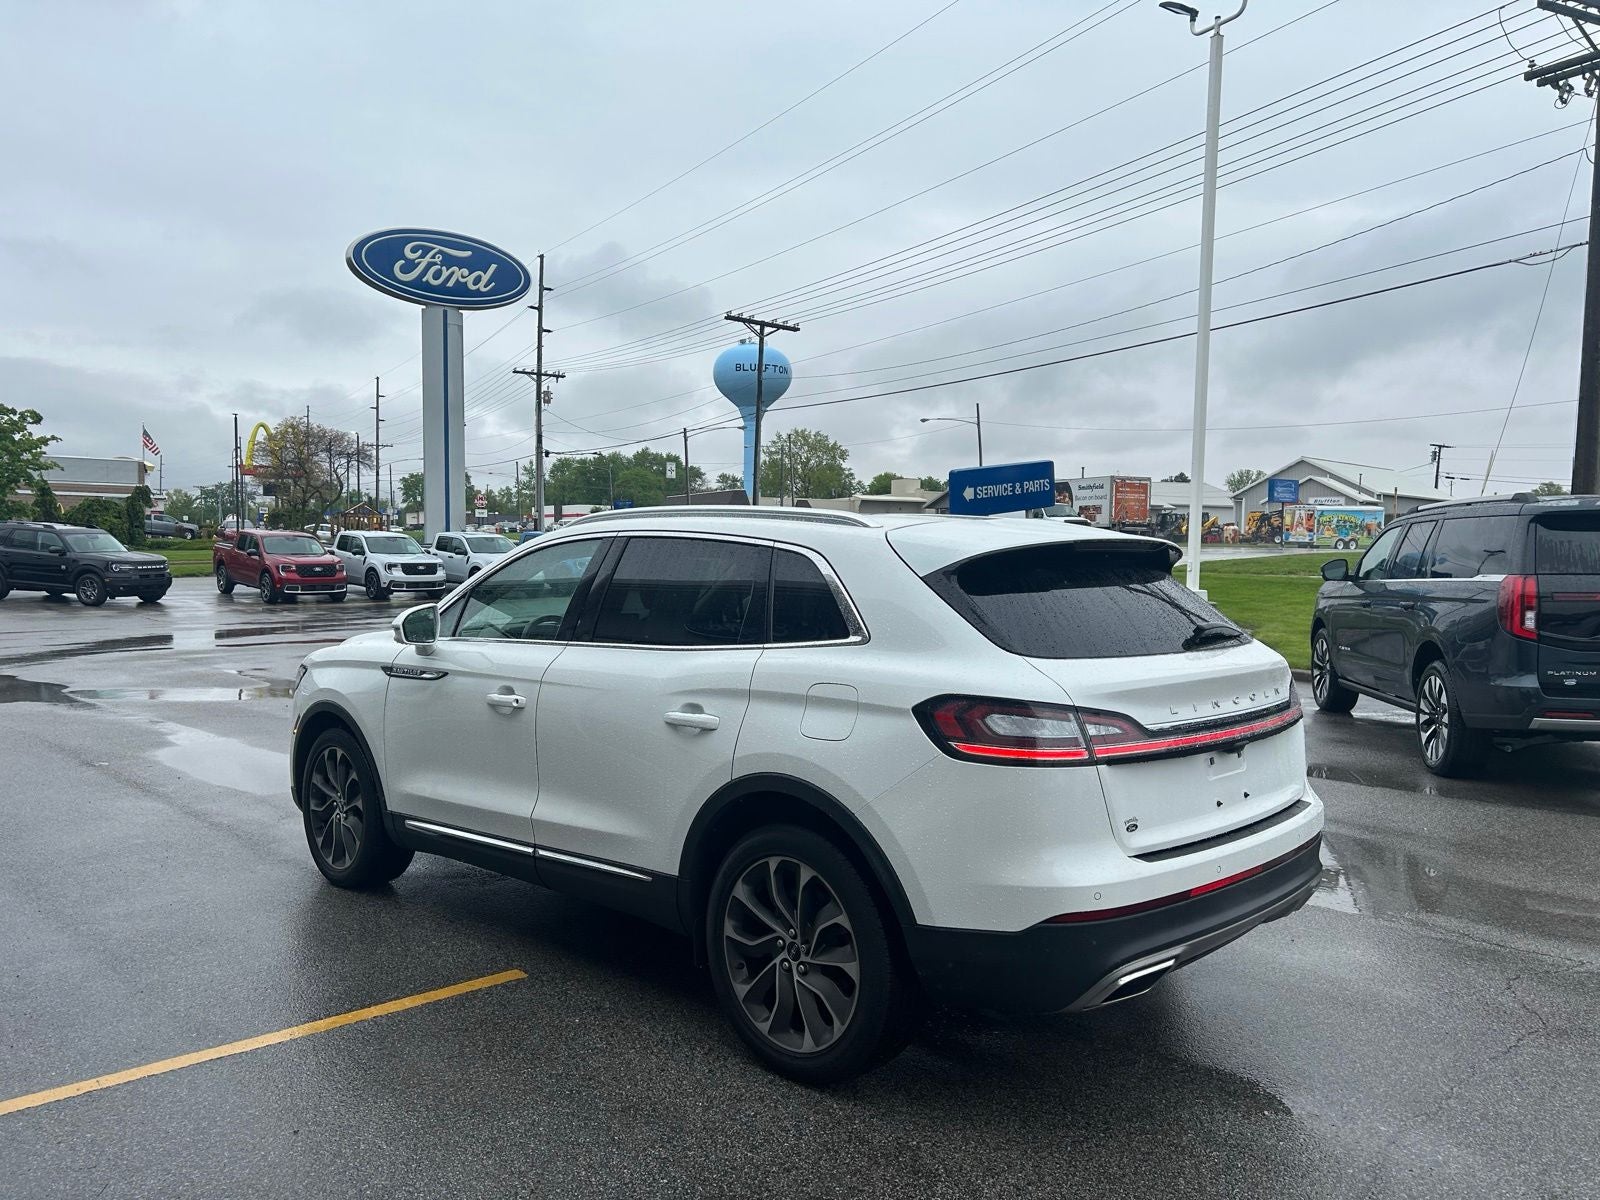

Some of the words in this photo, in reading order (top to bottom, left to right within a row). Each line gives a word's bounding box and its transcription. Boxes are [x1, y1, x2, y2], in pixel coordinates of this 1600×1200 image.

[393, 241, 498, 292] Ford
[735, 363, 789, 375] BLUFTON
[976, 483, 1013, 499] SERVICE
[1014, 482, 1022, 495] &
[1023, 478, 1050, 493] PARTS
[1078, 483, 1104, 493] Smithfield
[1169, 687, 1280, 715] LINCOLN
